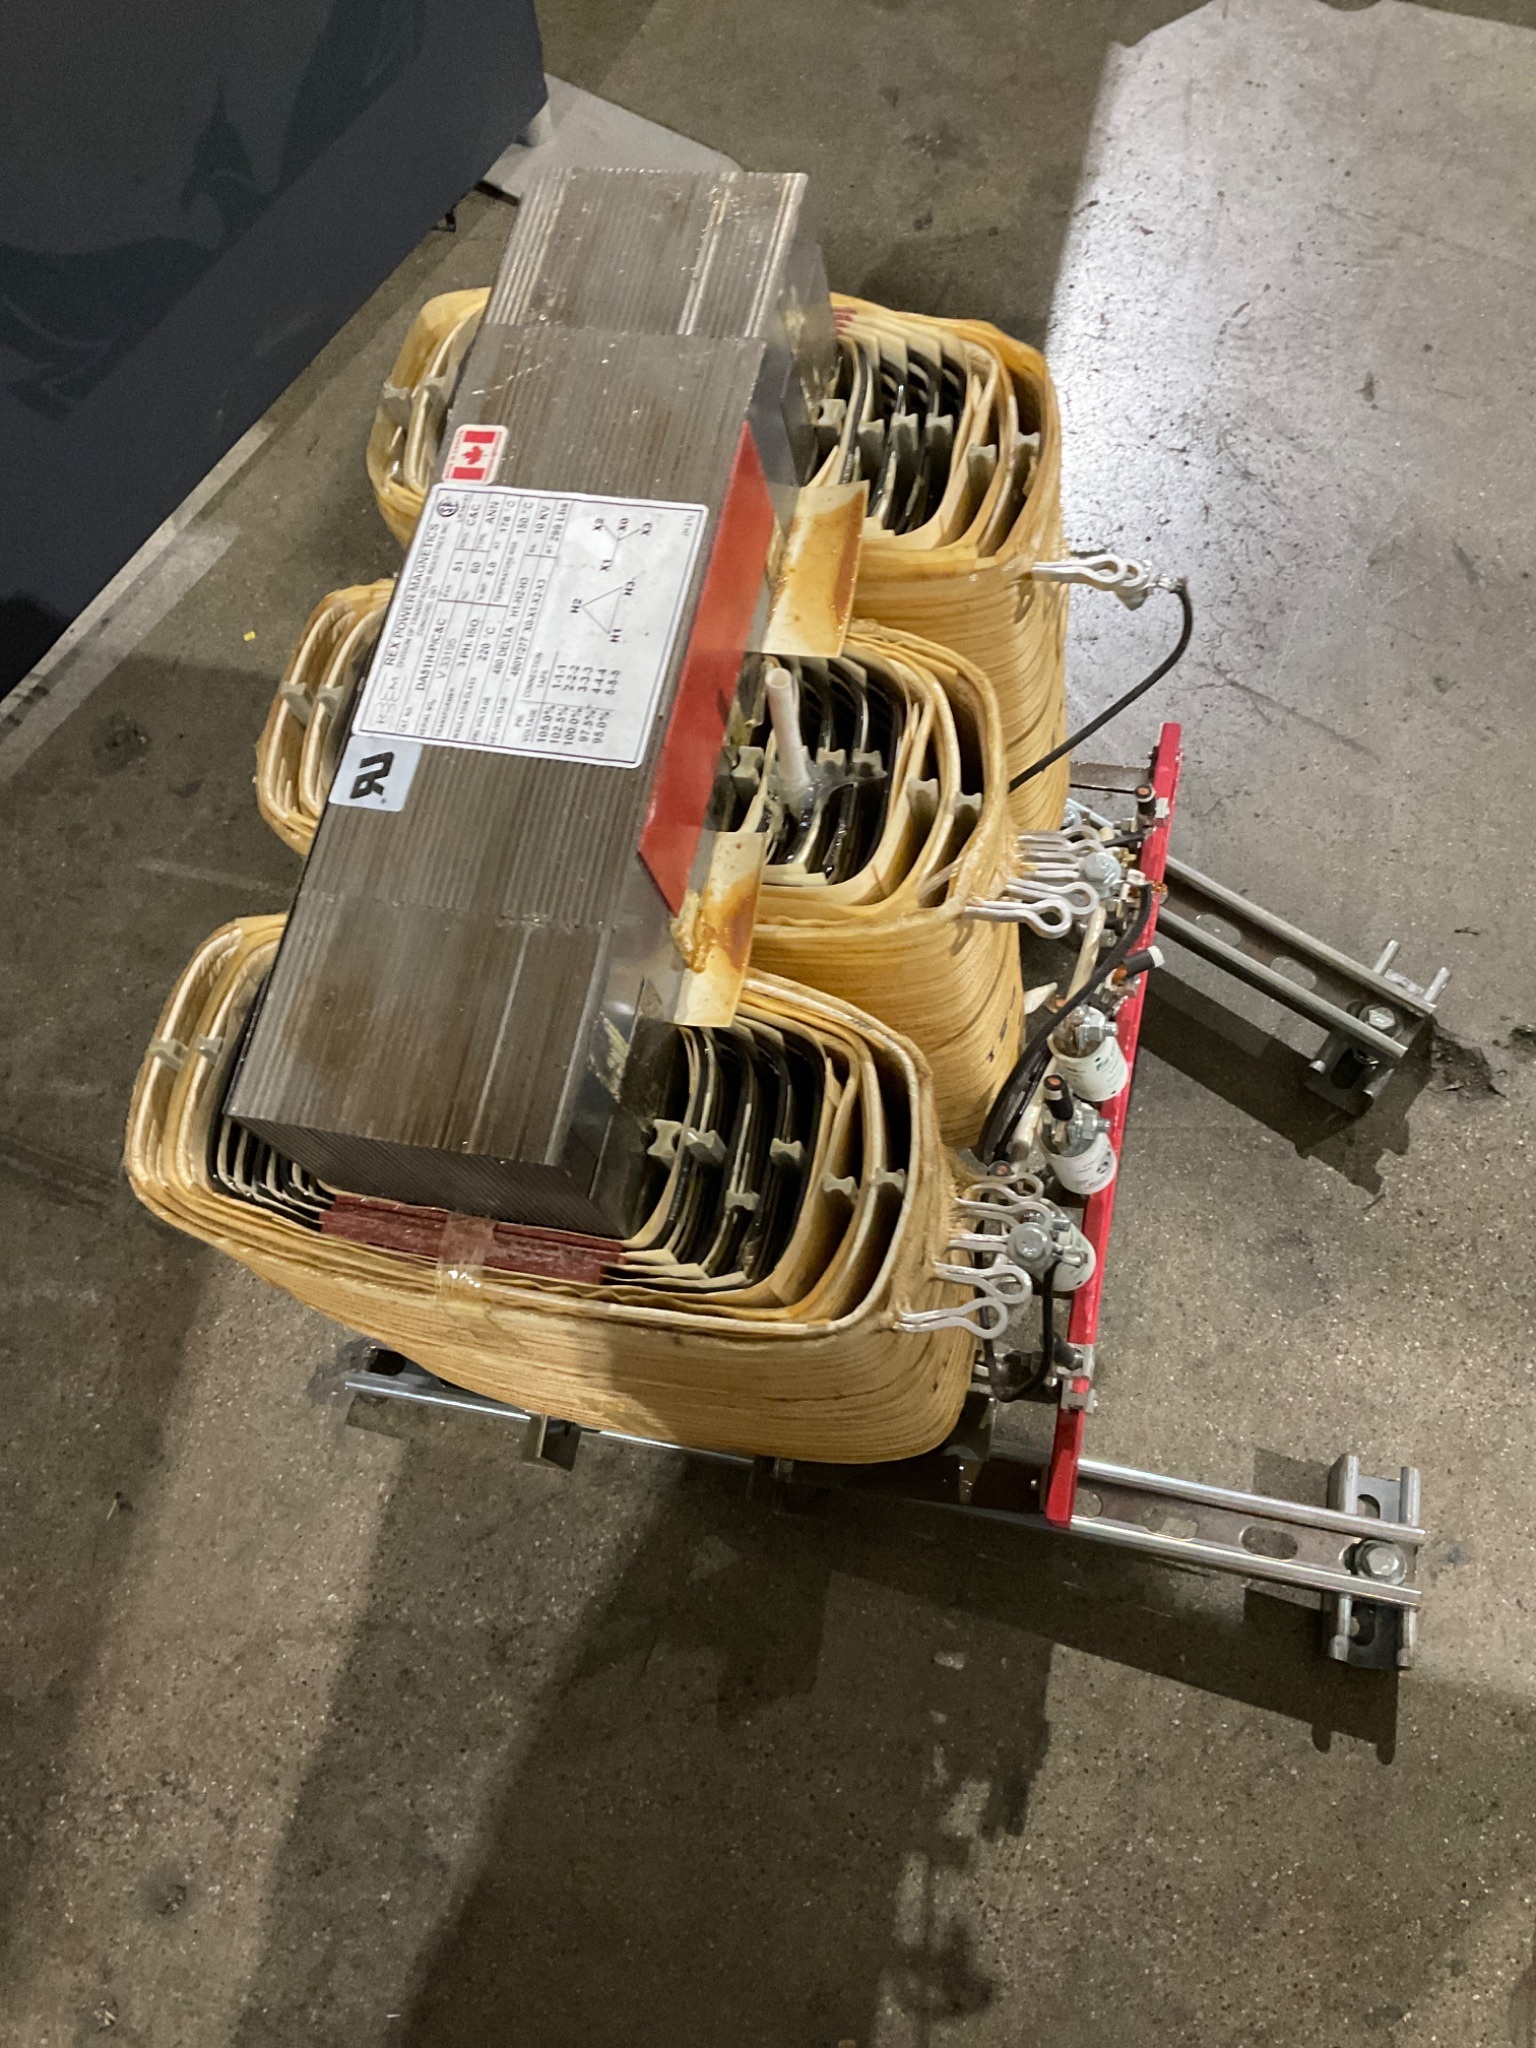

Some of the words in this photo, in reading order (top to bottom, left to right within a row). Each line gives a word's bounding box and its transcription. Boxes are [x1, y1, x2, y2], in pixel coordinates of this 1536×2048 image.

[465, 504, 482, 526] C&C
[484, 501, 500, 524] ANN
[537, 505, 551, 520] KV
[555, 502, 570, 521] Lbs
[515, 517, 530, 534] 150
[533, 522, 546, 533] 10
[549, 524, 564, 541] 299
[592, 518, 605, 531] X2
[617, 518, 630, 531] X0
[640, 522, 653, 536] X3
[426, 536, 445, 575] INDUSTRIES
[452, 561, 464, 572] 51
[469, 561, 482, 574] 60
[599, 559, 612, 571] X1
[485, 561, 498, 576] 5.0
[493, 557, 514, 602] TEMPERATURE
[384, 642, 401, 665] REX
[393, 594, 416, 638] POWER
[408, 524, 439, 591] MAGNETICS
[409, 576, 432, 625] TRANSFACTOR
[507, 576, 530, 618] H1-H2-H3
[622, 580, 636, 596] H3
[521, 578, 547, 632] X0-X1-X2-X3
[569, 598, 583, 614] H2
[405, 627, 416, 637] OF
[496, 626, 515, 657] DELTA
[609, 628, 622, 643] H1
[395, 639, 412, 668] DIVISION
[414, 617, 447, 691] DA51H-P/C&C
[438, 637, 458, 669] 33195
[475, 642, 492, 661] 220
[435, 671, 448, 679] V
[491, 658, 505, 675] 480
[522, 651, 543, 698] CONNECTION
[537, 670, 549, 688] TAPS
[551, 664, 568, 689] 1-1-1
[562, 665, 580, 691] 2-2-2
[576, 666, 593, 693] 3-3-3
[590, 668, 607, 694] 4-4-4
[604, 669, 621, 696] 5-5-5
[435, 687, 456, 737] TRANSFORMER
[451, 699, 470, 739] INSULATION
[536, 704, 556, 742] 105.0%
[521, 708, 538, 742] VOLTAGE
[548, 706, 569, 744] 102.5%
[561, 707, 583, 746] 100.0%
[577, 709, 596, 742] 97.5%
[591, 710, 611, 744] 95.0%
